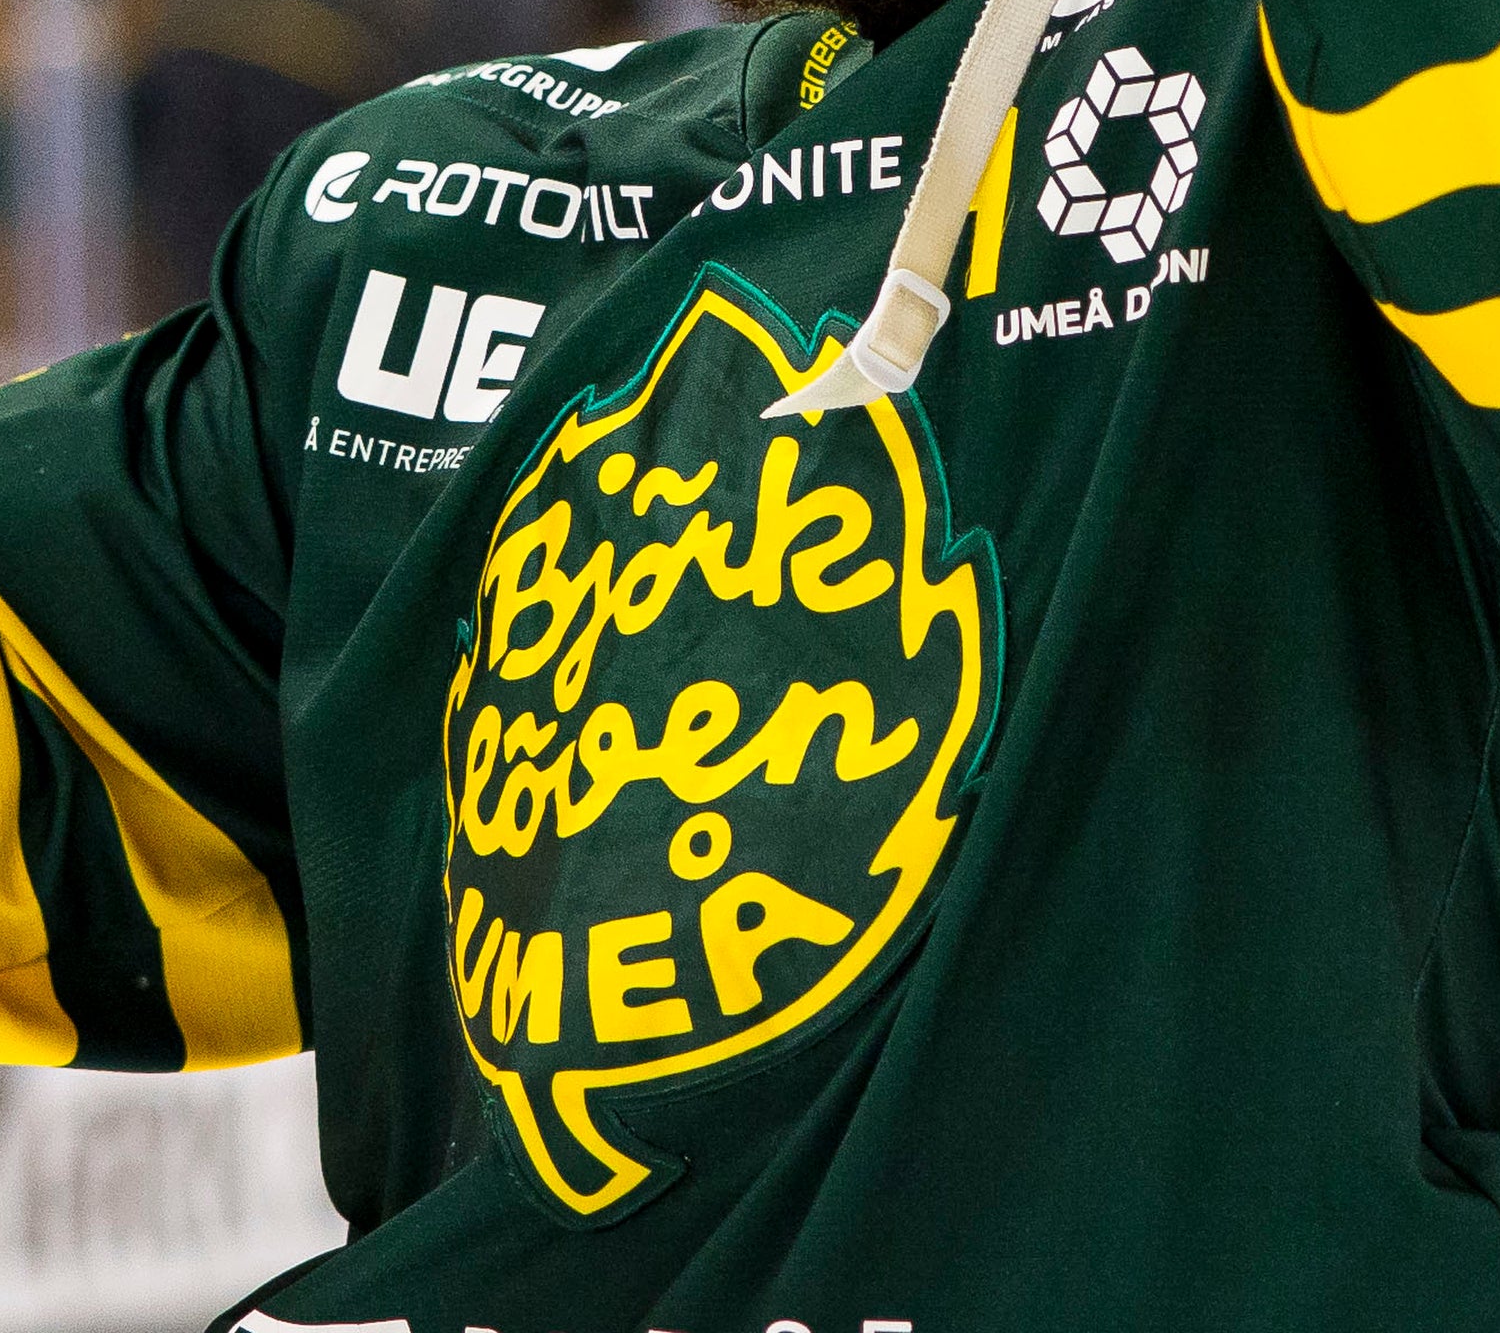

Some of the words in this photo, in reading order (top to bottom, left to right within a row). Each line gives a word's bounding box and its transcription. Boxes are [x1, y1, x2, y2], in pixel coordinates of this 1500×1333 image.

[690, 135, 904, 218] ONITE
[995, 286, 1114, 346] UMEÅ
[328, 428, 475, 474] ENTREPRE
[484, 435, 894, 713] Björk
[454, 810, 855, 1046] UMEÅ
